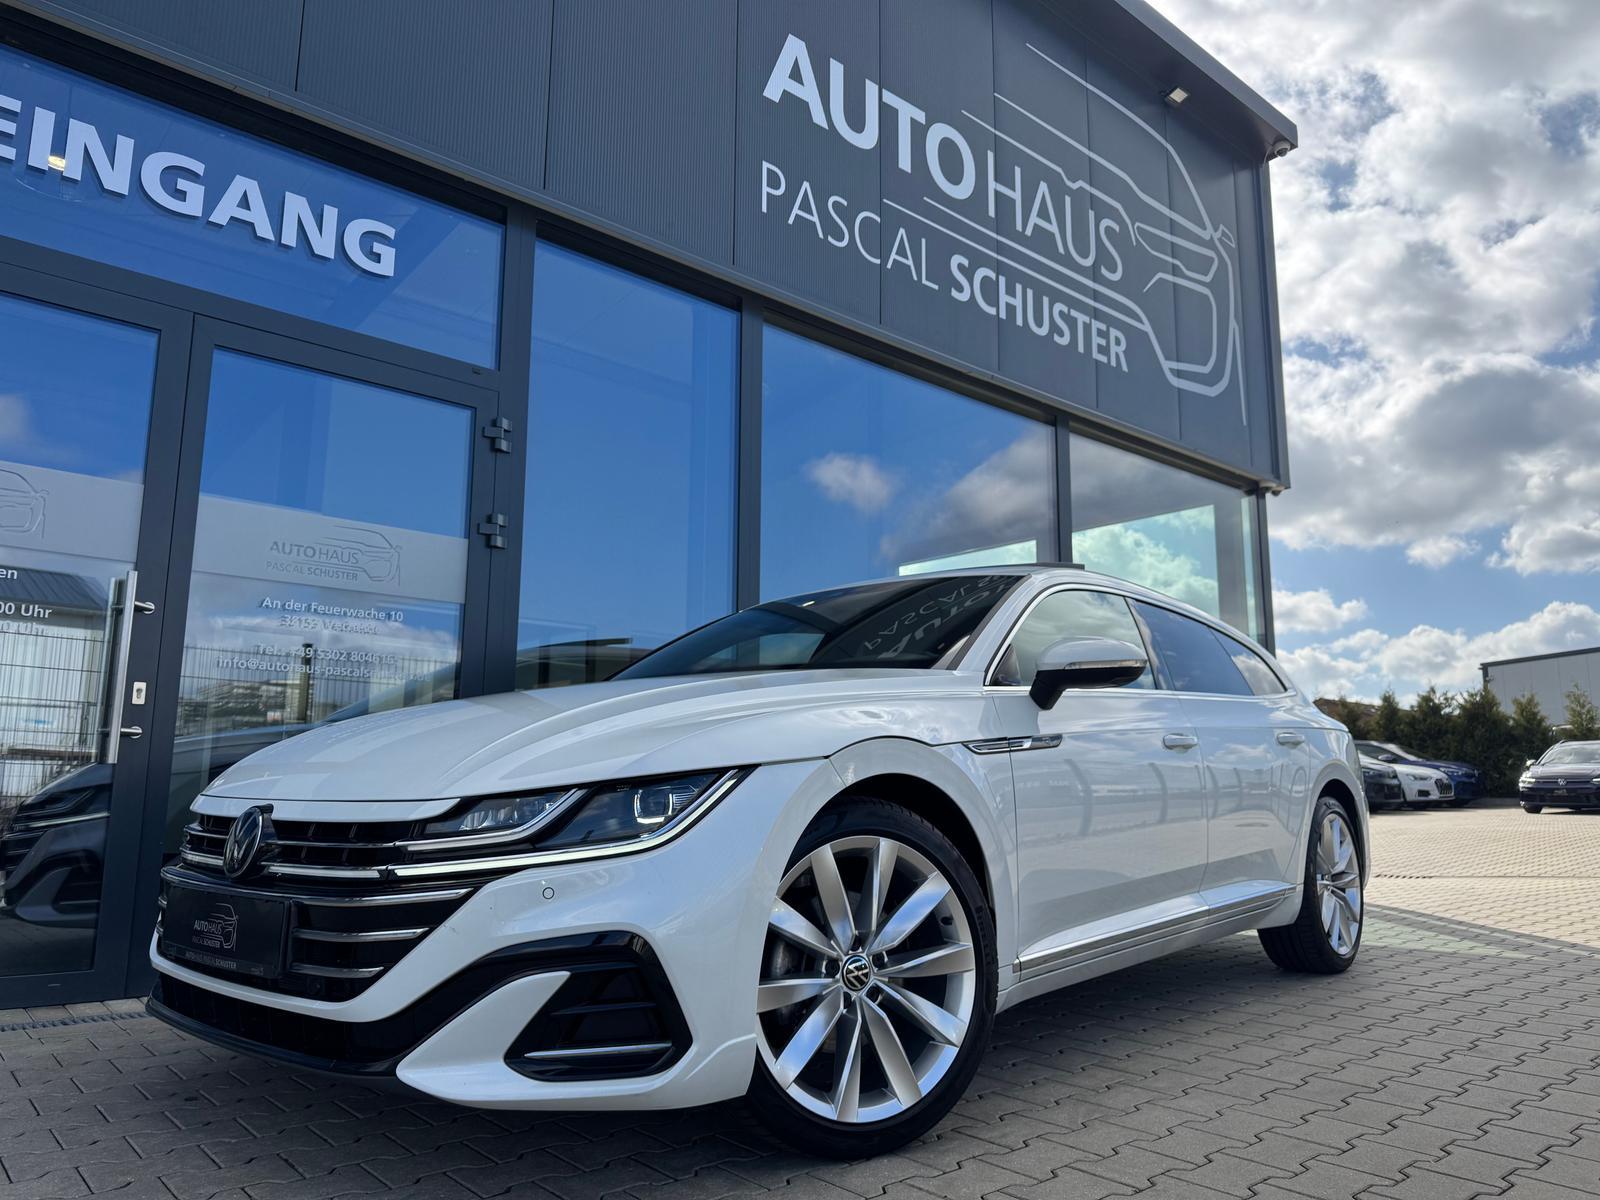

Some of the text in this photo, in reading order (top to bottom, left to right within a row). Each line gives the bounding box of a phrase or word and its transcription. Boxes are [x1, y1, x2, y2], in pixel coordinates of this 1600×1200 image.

[763, 34, 1123, 282] AUTOHAUS
[0, 94, 396, 277] EINGANG
[761, 160, 1129, 373] PASCAL SCHUSTER
[266, 561, 359, 582] PASCAL SCHUSTER
[20, 604, 53, 618] Uhr
[262, 597, 404, 622] An der Feuerwache 10
[317, 649, 348, 662] 5302
